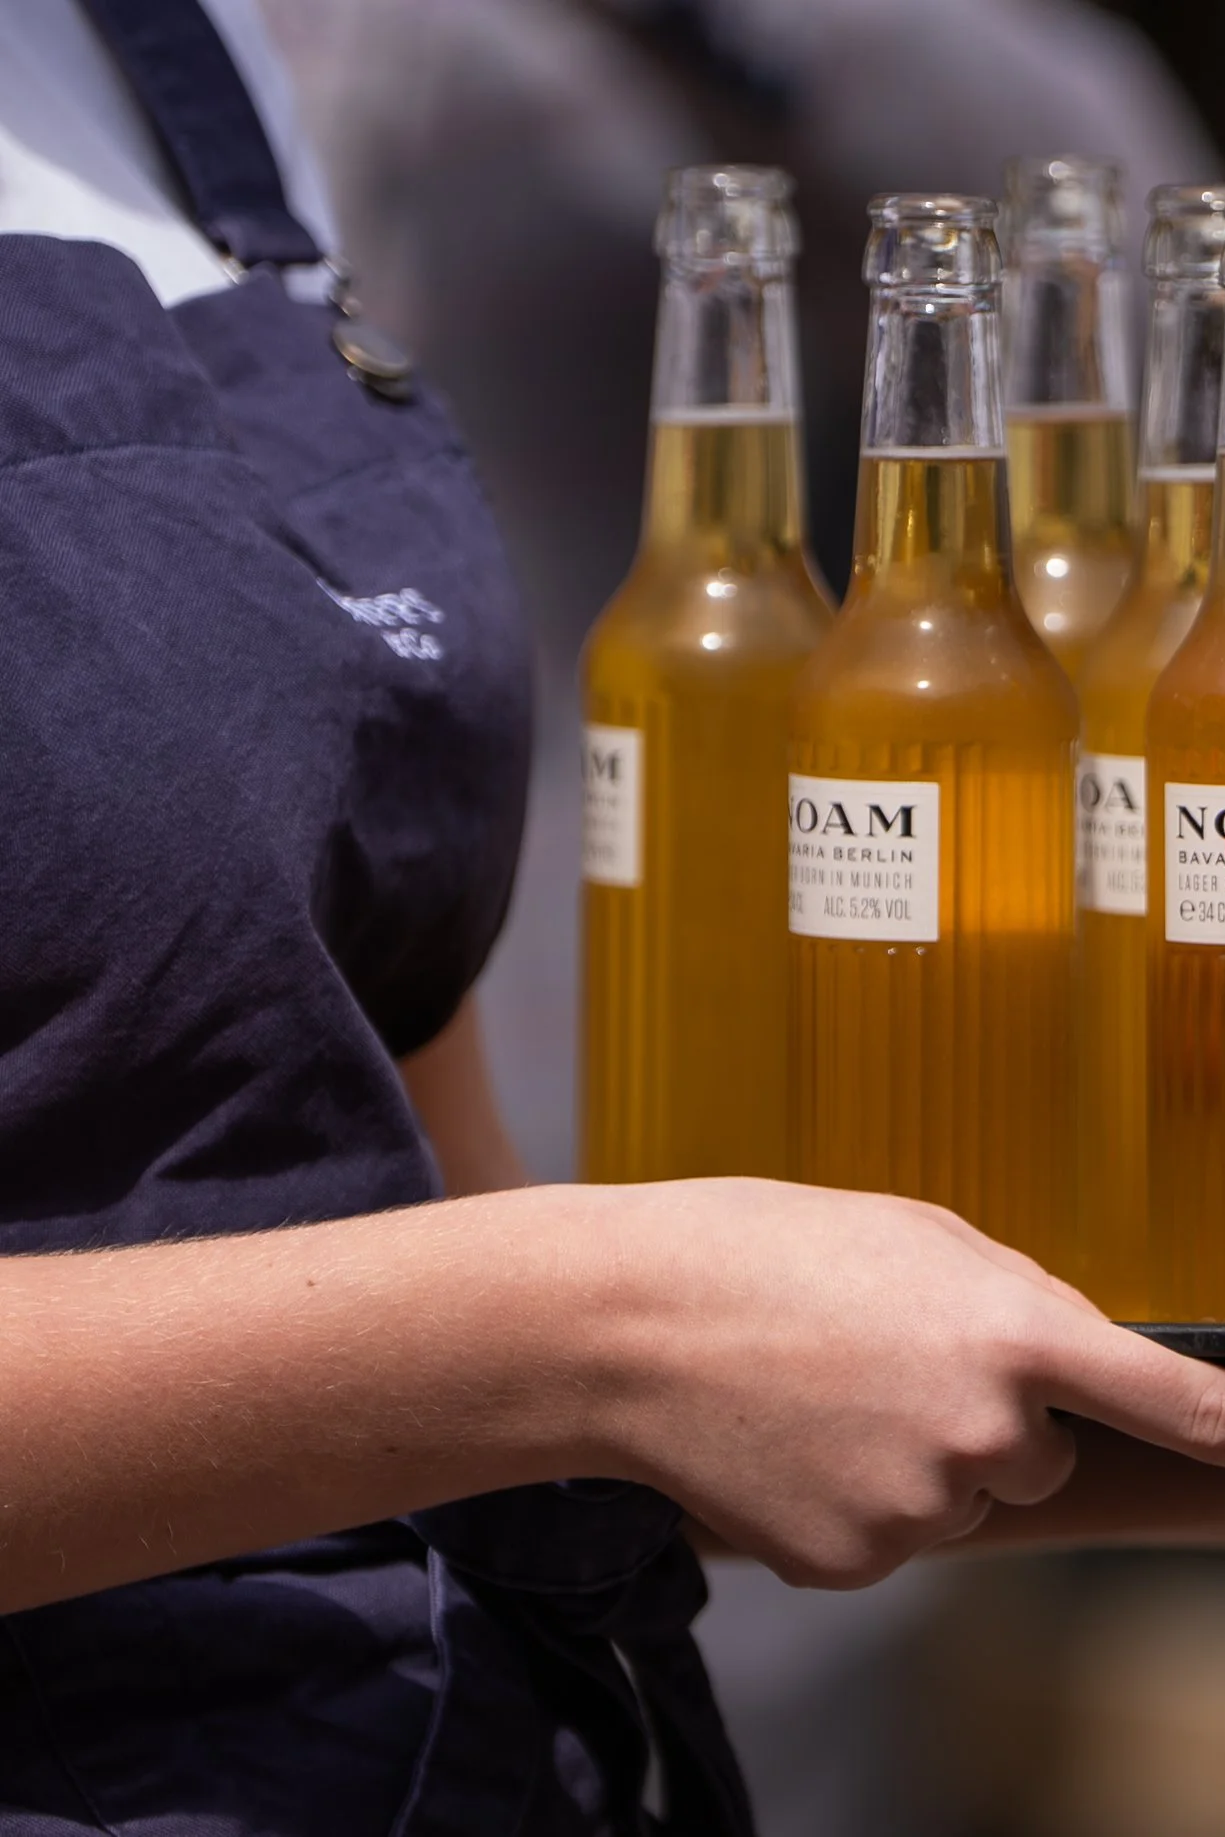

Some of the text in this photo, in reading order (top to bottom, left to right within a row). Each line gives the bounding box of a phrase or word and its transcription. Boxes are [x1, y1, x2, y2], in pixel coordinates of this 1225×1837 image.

[832, 846, 914, 864] BERLIN
[1178, 850, 1225, 867] BAVA
[830, 869, 843, 888] IN
[850, 871, 913, 892] MUNICH
[1178, 873, 1218, 893] LAGER
[823, 895, 848, 920] ALC.
[849, 898, 882, 921] 5.2%
[884, 898, 912, 922] VOL
